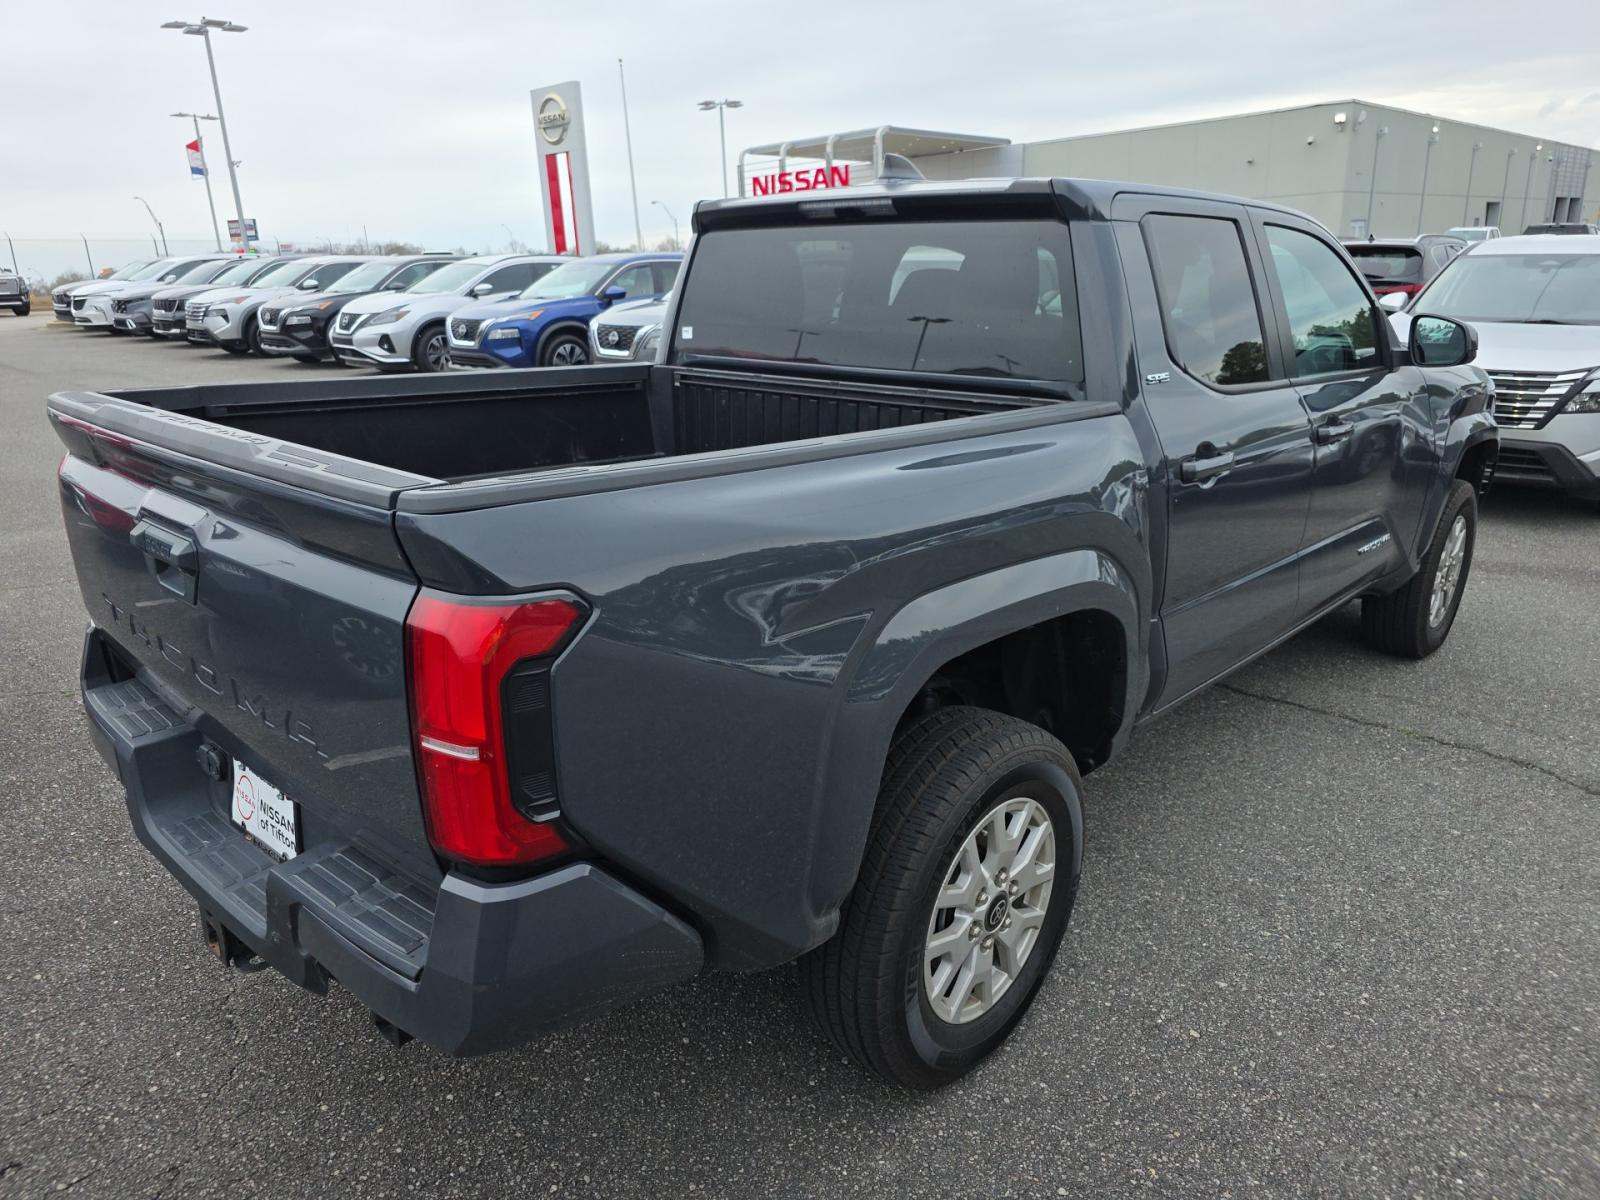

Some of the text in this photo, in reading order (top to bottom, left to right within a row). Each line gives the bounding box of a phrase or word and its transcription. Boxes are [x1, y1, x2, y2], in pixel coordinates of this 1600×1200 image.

[752, 165, 849, 197] NISSAN
[102, 592, 327, 759] TACOMA
[260, 799, 295, 835] NISSAN
[260, 819, 269, 832] of
[270, 823, 296, 851] Tifton
